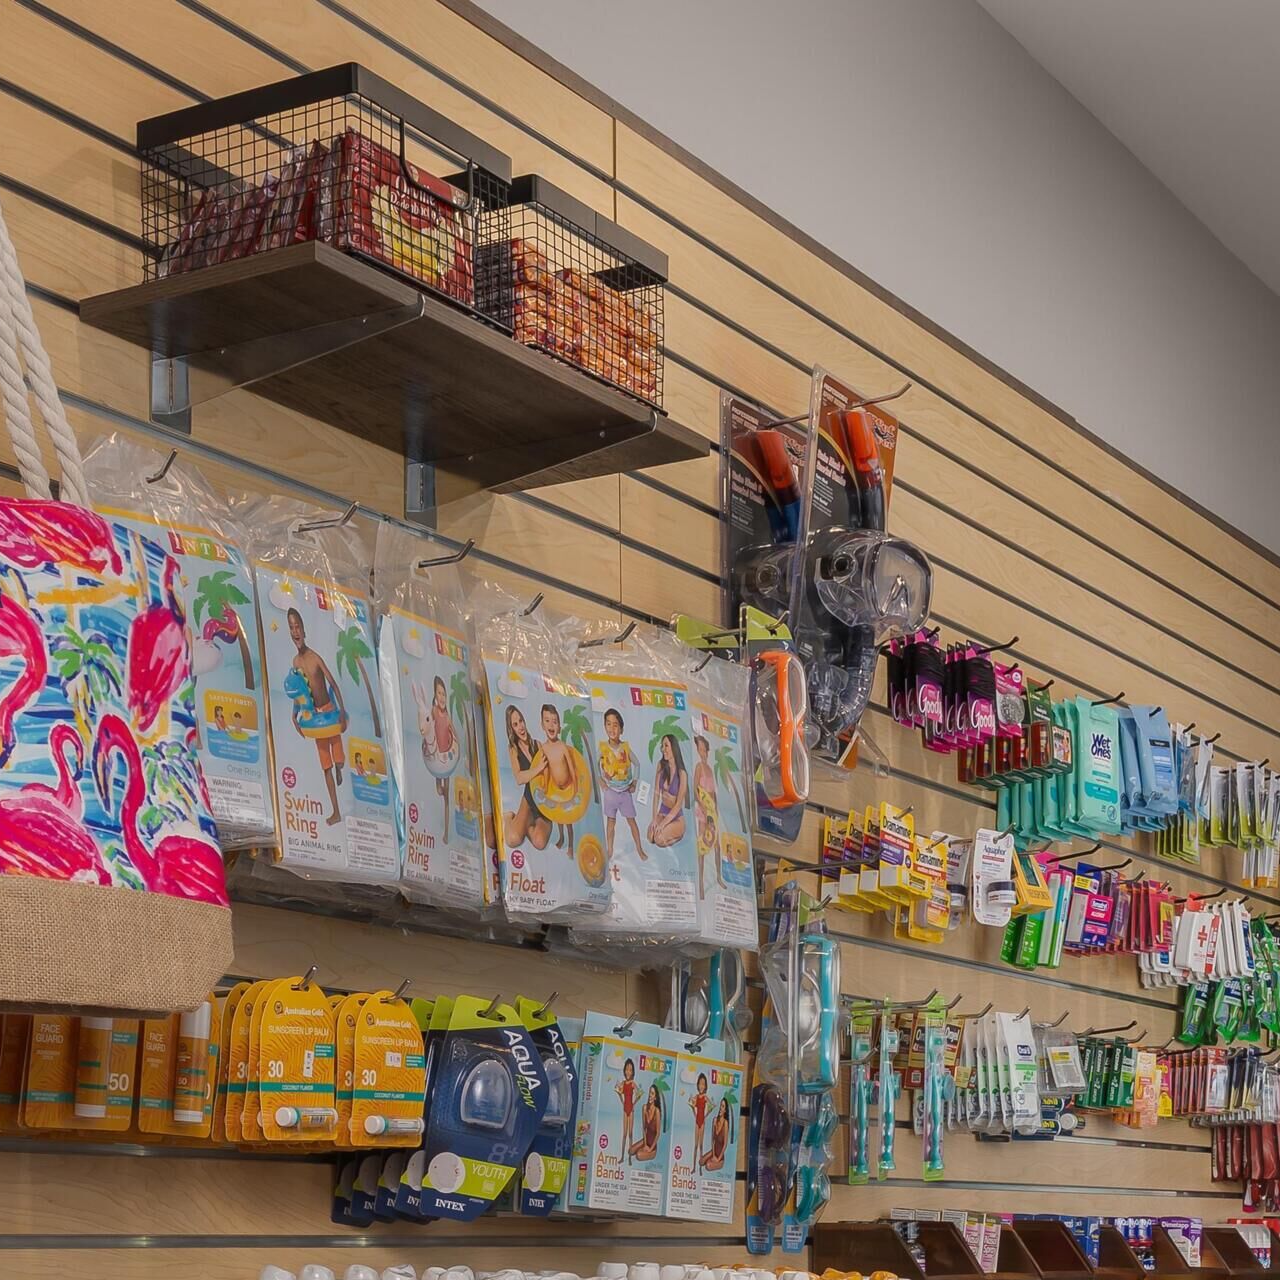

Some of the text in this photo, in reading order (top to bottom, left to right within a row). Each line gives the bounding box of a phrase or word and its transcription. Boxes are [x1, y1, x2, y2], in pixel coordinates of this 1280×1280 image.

[633, 689, 686, 709] INTEX
[971, 700, 995, 731] Goody
[1092, 733, 1111, 748] Wet
[1091, 745, 1111, 760] Ones
[244, 766, 262, 778] Ring
[284, 791, 323, 816] Swim
[286, 812, 317, 838] Ring
[883, 815, 911, 839] Dramamine
[288, 837, 326, 851] BIG ANIMAL
[409, 828, 435, 849] Swim
[983, 845, 1007, 857] Aquaphor
[408, 847, 430, 872] Ring
[916, 850, 944, 868] Dramamine
[510, 871, 546, 894] Float
[40, 1023, 61, 1034] FACE
[269, 1025, 303, 1036] SUNSCREEN
[35, 1033, 64, 1044] GUARD
[149, 1033, 165, 1043] FACE
[362, 1036, 394, 1046] SUNSCREEN
[146, 1042, 166, 1052] GUARD
[503, 1029, 541, 1092] AQUA
[268, 1060, 284, 1078] 30
[108, 1073, 129, 1092] 50
[362, 1069, 377, 1086] 30
[547, 1160, 566, 1172] YOUTH
[597, 1151, 617, 1166] Arm
[472, 1162, 507, 1179] YOUTH
[596, 1165, 624, 1180] Bands
[672, 1163, 691, 1175] Arm
[672, 1176, 696, 1190] Bands
[436, 1198, 465, 1211] INTEX
